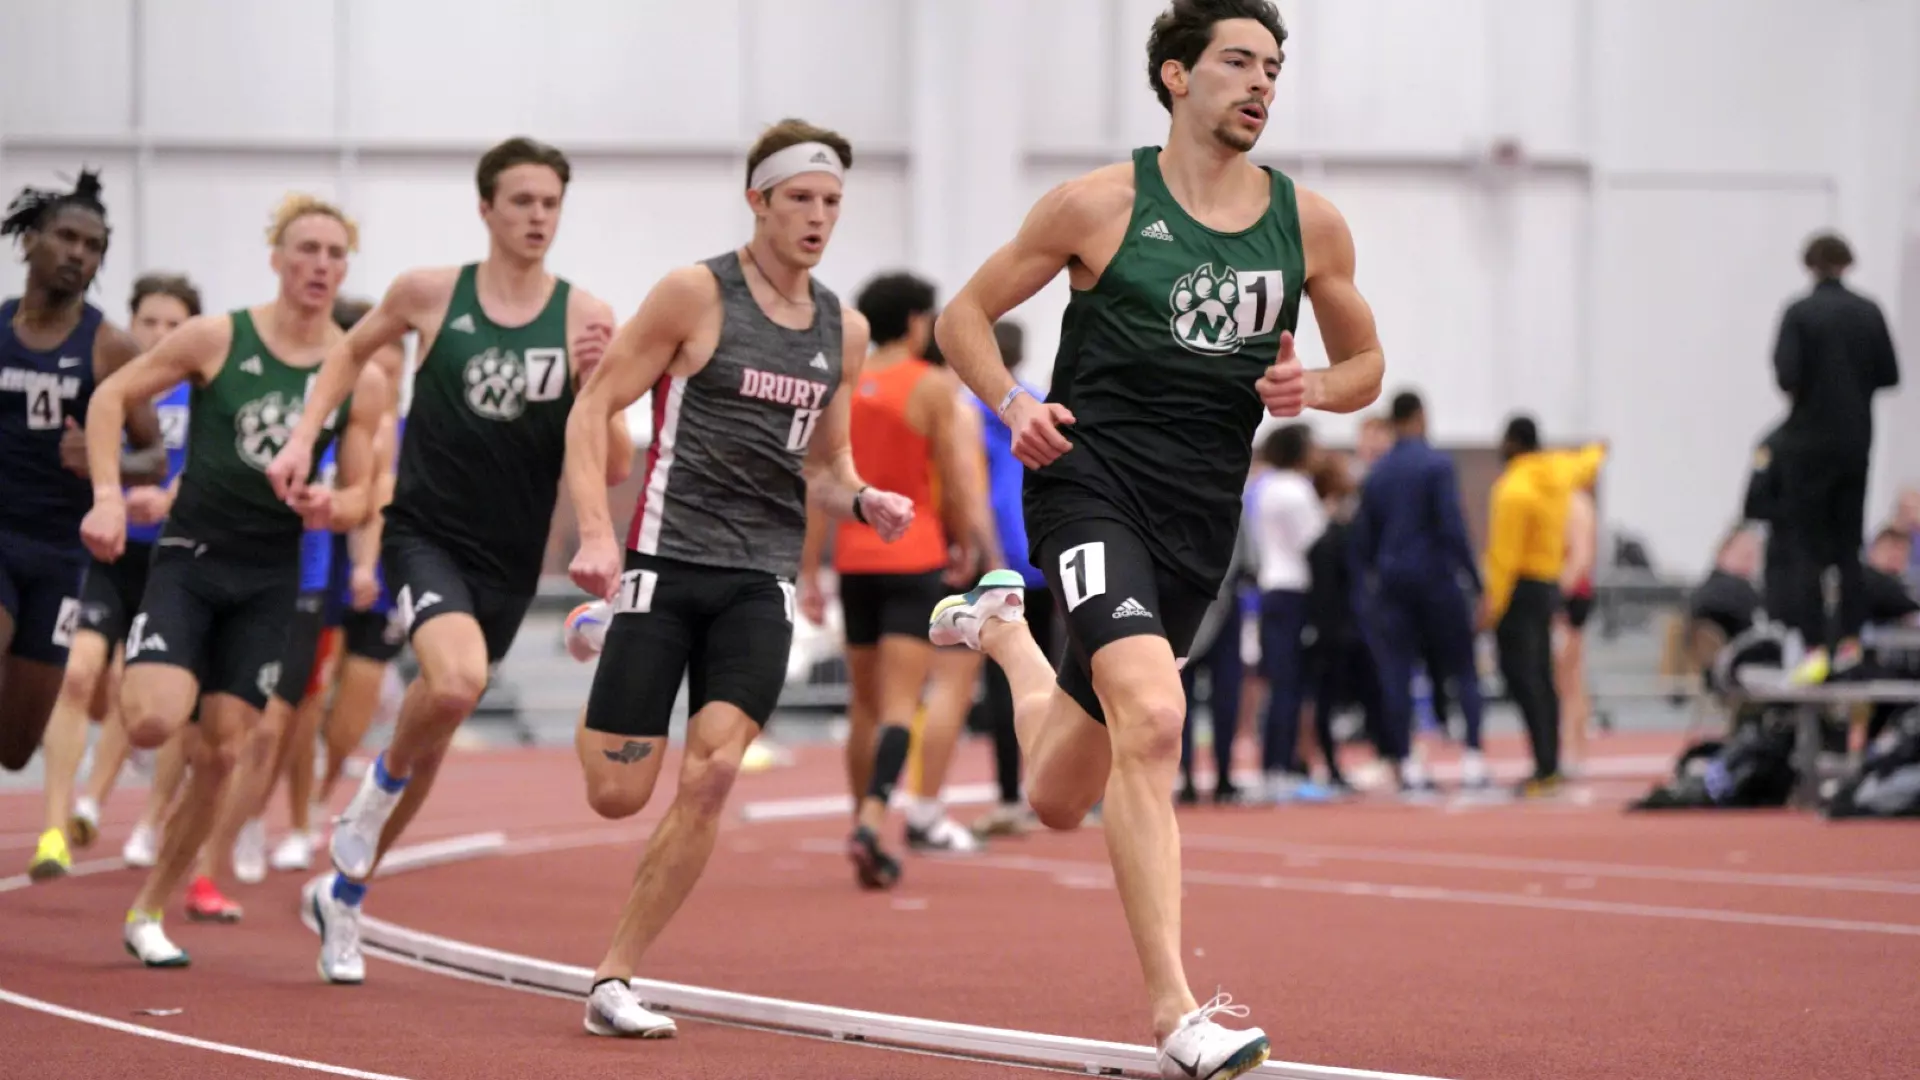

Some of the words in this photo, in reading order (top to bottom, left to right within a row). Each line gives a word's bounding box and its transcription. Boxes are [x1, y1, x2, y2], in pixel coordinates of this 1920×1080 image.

[1141, 229, 1173, 241] adidas
[1245, 276, 1267, 333] 1
[1185, 311, 1228, 345] N
[532, 355, 556, 395] 7
[739, 367, 828, 410] DRURY
[31, 389, 52, 422] 4
[1065, 548, 1087, 600] 1
[1112, 609, 1153, 619] adidas
